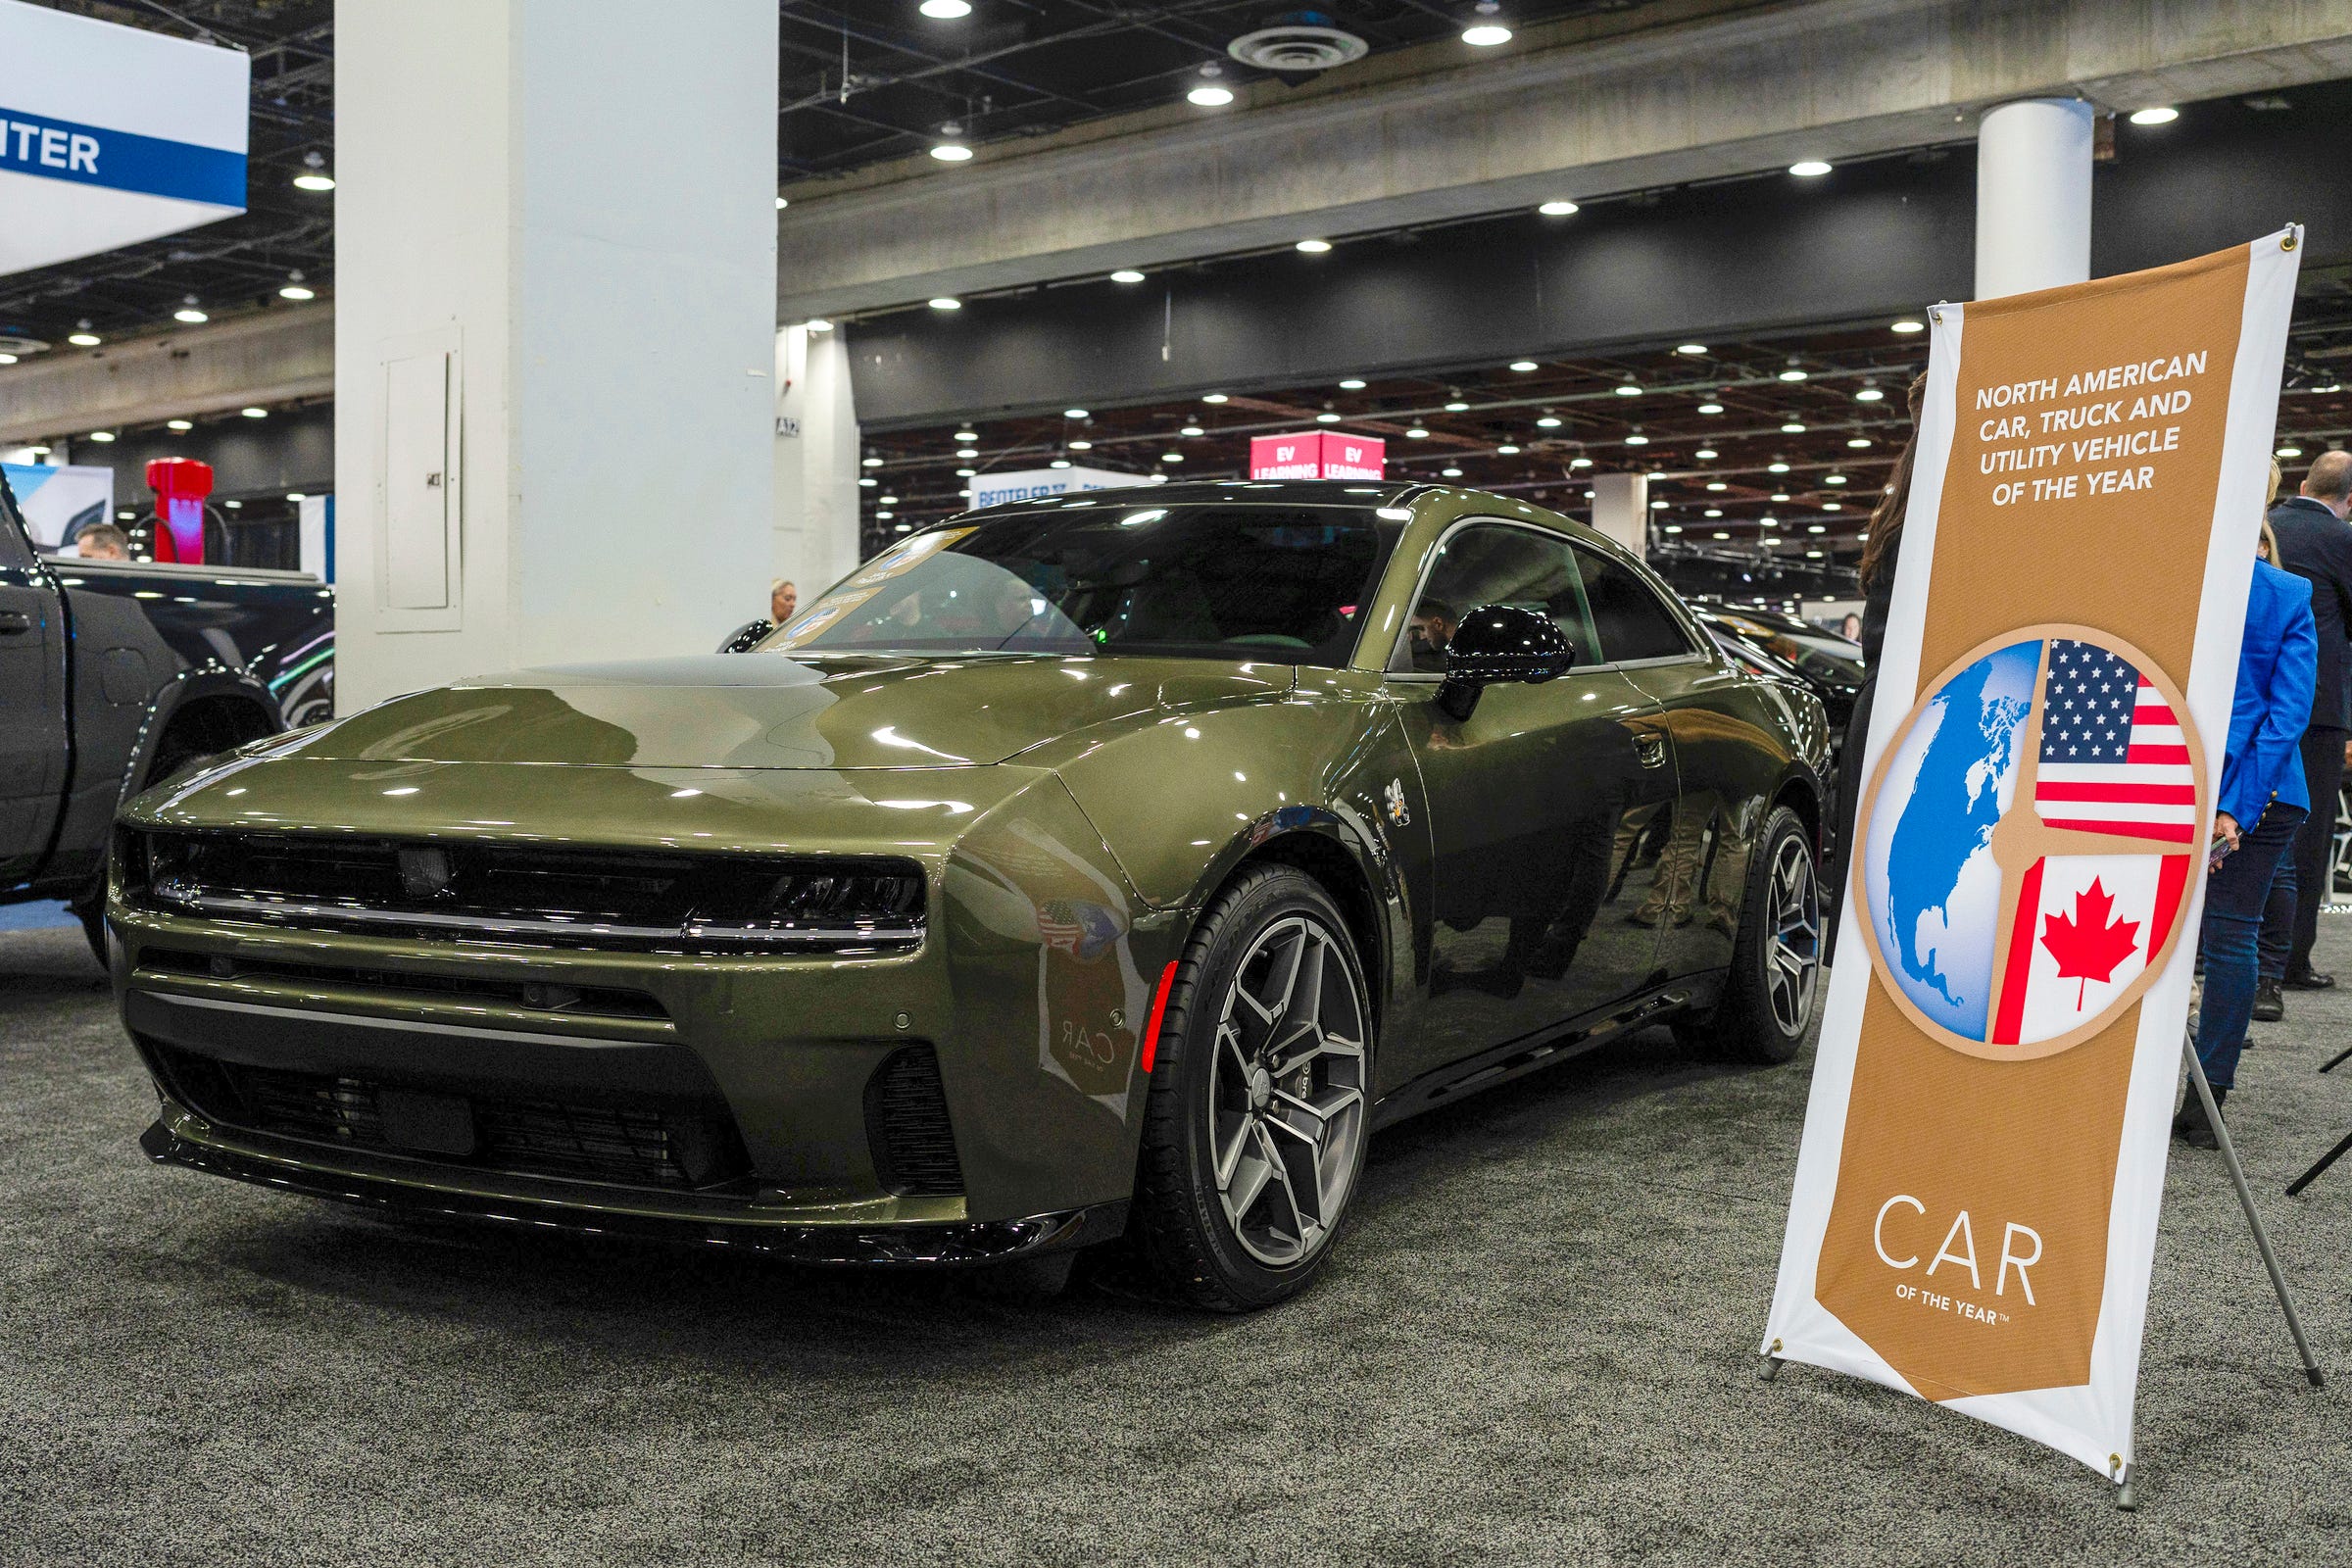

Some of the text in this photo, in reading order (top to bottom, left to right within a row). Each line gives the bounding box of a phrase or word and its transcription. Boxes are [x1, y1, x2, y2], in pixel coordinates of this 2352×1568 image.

[0, 119, 100, 174] TER
[1976, 350, 2207, 410] NORTH AMERICAN
[1979, 390, 2191, 442] CAR, TRUCK AND
[1276, 446, 1296, 462] EV
[1345, 446, 1362, 463] EV
[1980, 426, 2180, 474] UTILITY VEHICLE
[1253, 463, 1318, 480] LEARNING
[1324, 464, 1383, 480] LEARNING
[1991, 466, 2155, 507] OF THE YEAR
[1874, 1195, 2042, 1305] CAR
[1895, 1284, 1917, 1300] OF
[1921, 1290, 1950, 1311] THE
